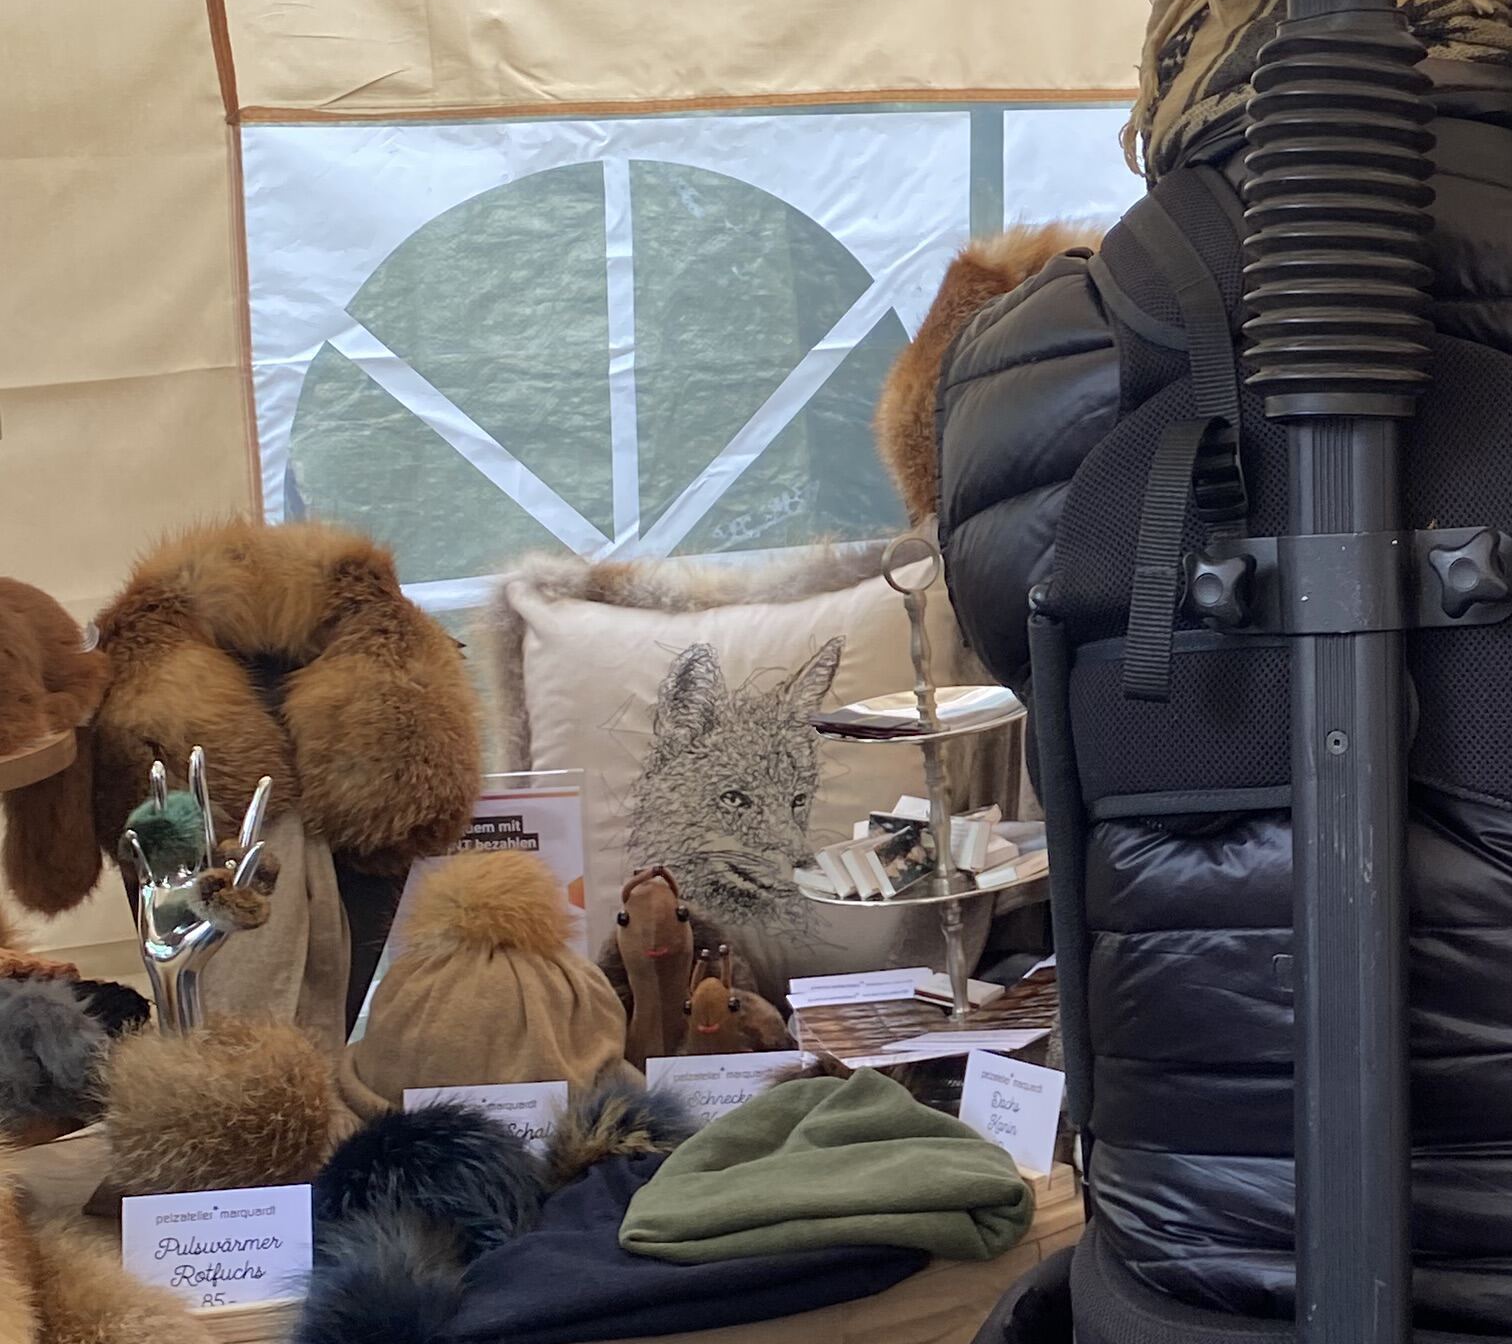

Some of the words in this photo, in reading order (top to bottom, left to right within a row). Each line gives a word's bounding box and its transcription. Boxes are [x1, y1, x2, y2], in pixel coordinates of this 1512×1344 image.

[498, 819, 521, 833] mit
[475, 836, 537, 851] bezahlen
[155, 1210, 214, 1226] pelzatelier
[219, 1205, 277, 1220] marquardt
[154, 1235, 284, 1261] Pulswärmer
[170, 1260, 267, 1288] Rotfuchs
